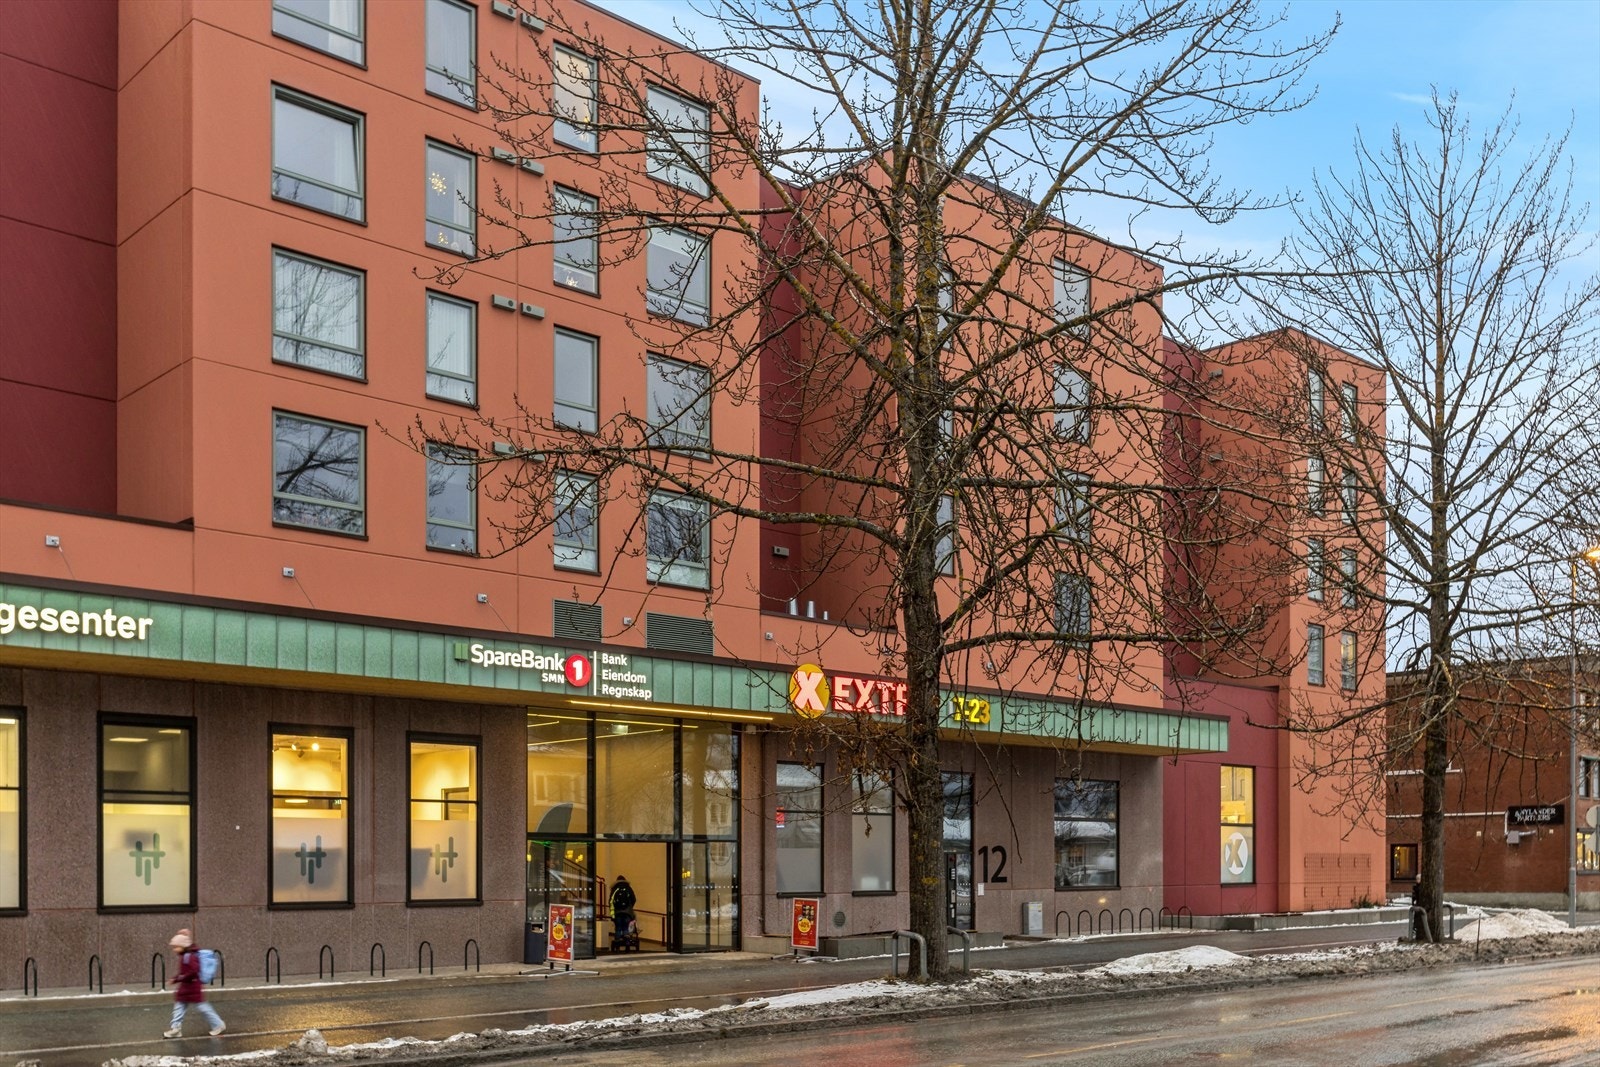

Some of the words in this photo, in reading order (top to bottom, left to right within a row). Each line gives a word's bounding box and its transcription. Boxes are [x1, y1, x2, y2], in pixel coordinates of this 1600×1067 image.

[0, 603, 153, 640] gesenter
[470, 643, 565, 671] SpareBank
[602, 653, 628, 666] Bank
[542, 672, 565, 684] SMN
[602, 669, 646, 684] Eiendom
[602, 684, 652, 701] Regnskap
[978, 845, 1008, 883] 12
